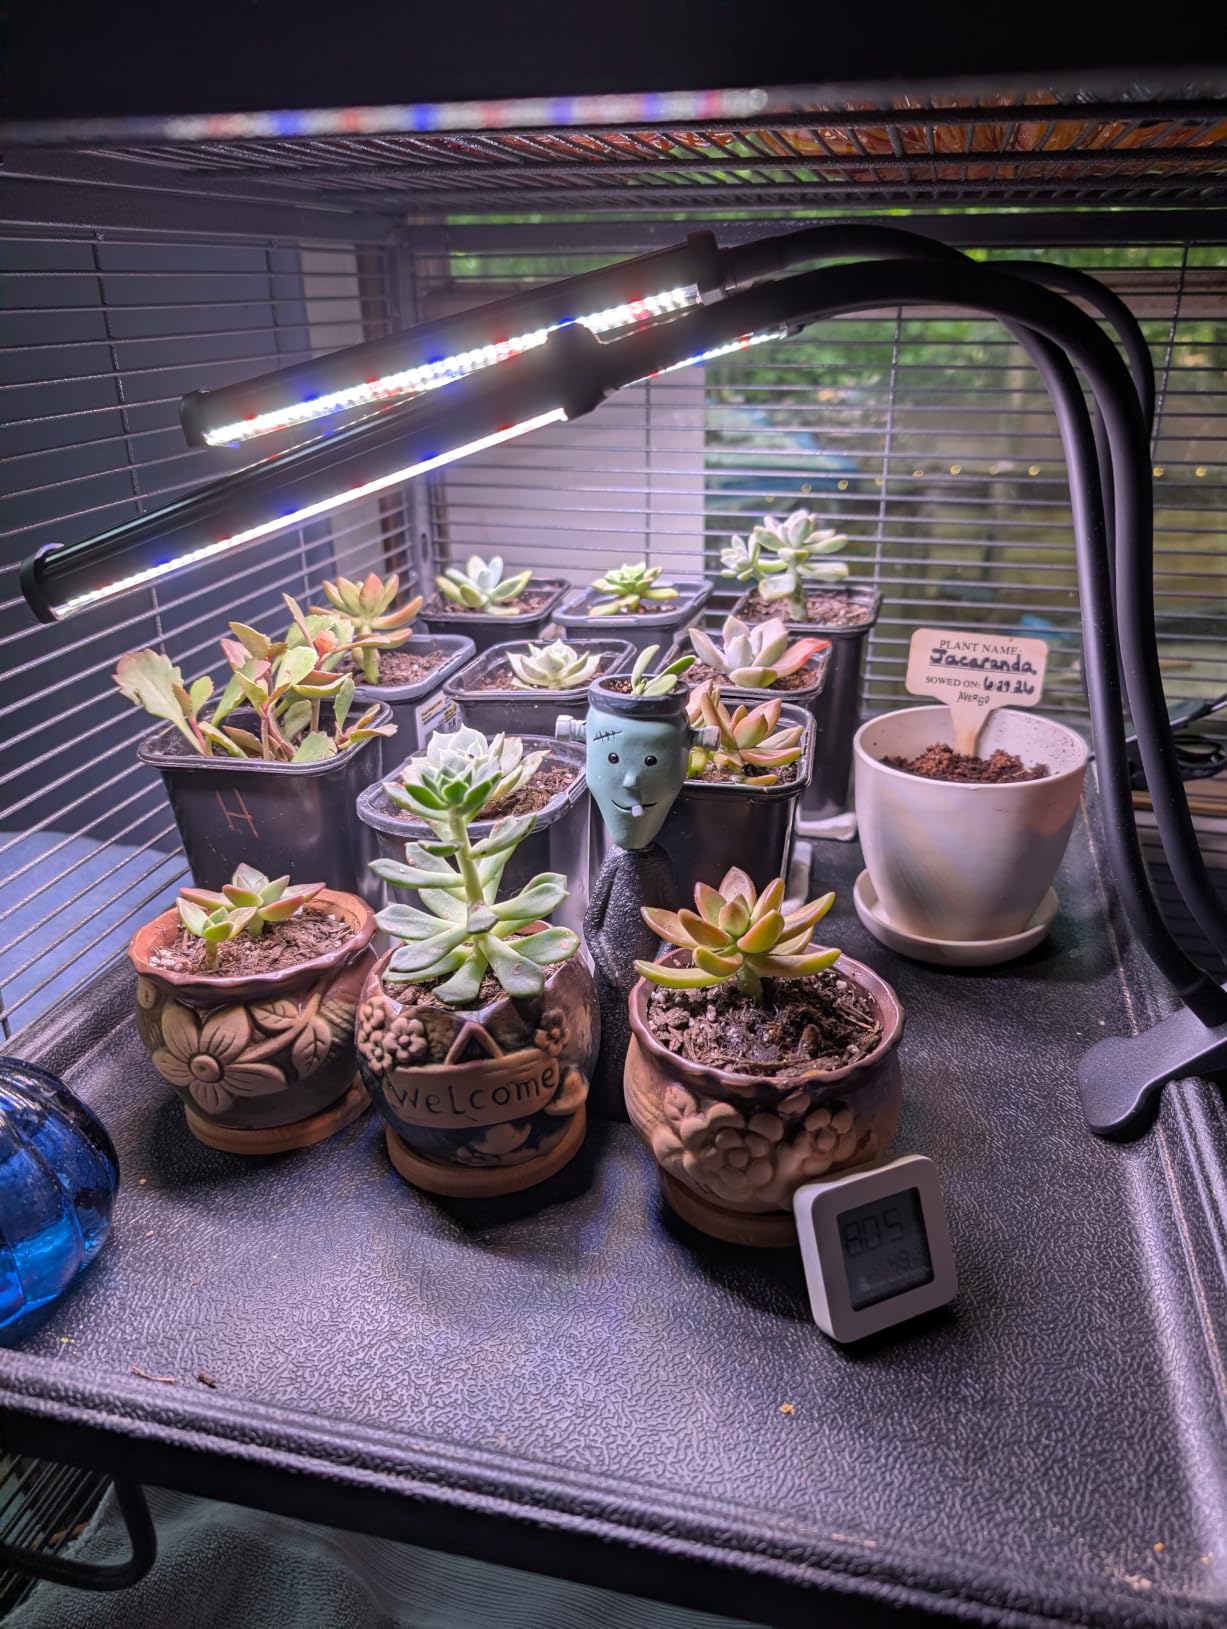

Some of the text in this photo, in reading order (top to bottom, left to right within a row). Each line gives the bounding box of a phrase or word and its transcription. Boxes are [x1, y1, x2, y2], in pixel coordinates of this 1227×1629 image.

[939, 640, 1022, 655] PLANT NAME:
[930, 648, 1037, 675] Jacaranda
[925, 676, 961, 687] SOWED
[962, 678, 981, 688] ON:
